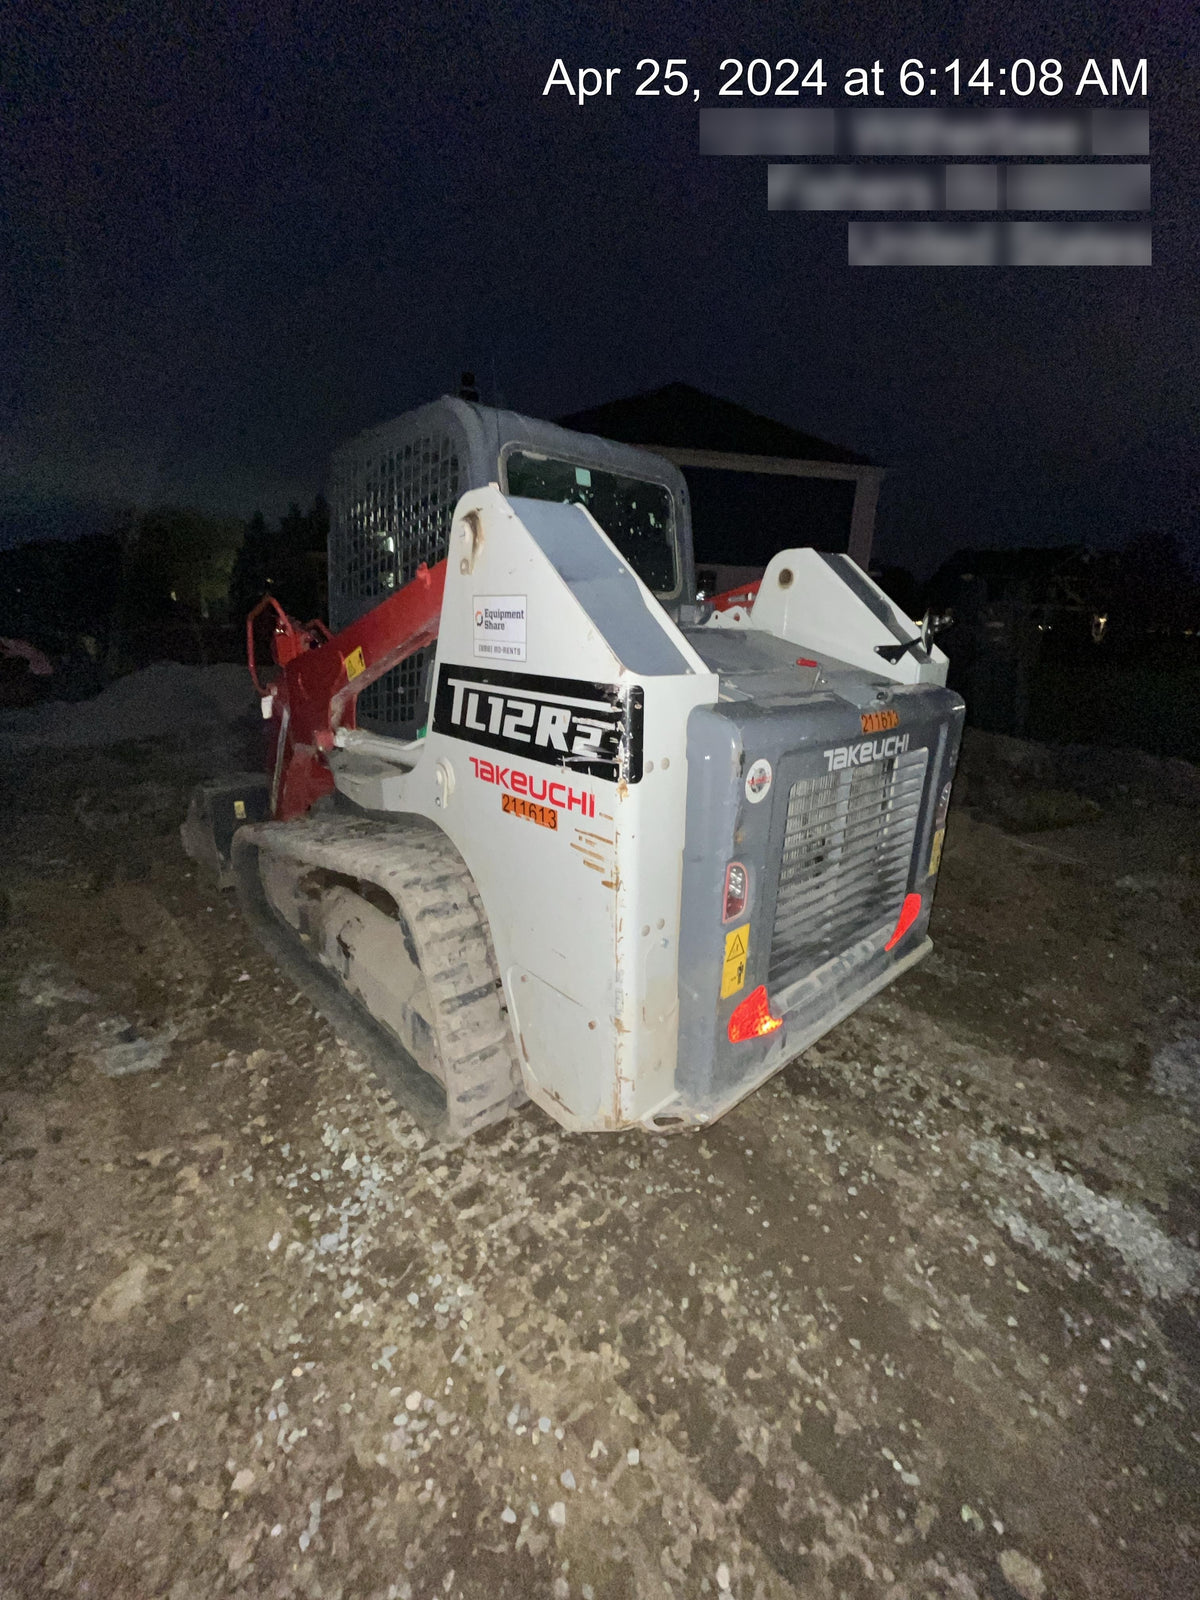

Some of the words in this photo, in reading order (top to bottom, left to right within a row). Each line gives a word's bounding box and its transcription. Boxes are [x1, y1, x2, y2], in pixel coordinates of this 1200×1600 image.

[484, 608, 525, 621] Equipment
[484, 620, 506, 631] Share
[502, 793, 558, 830] 211613
